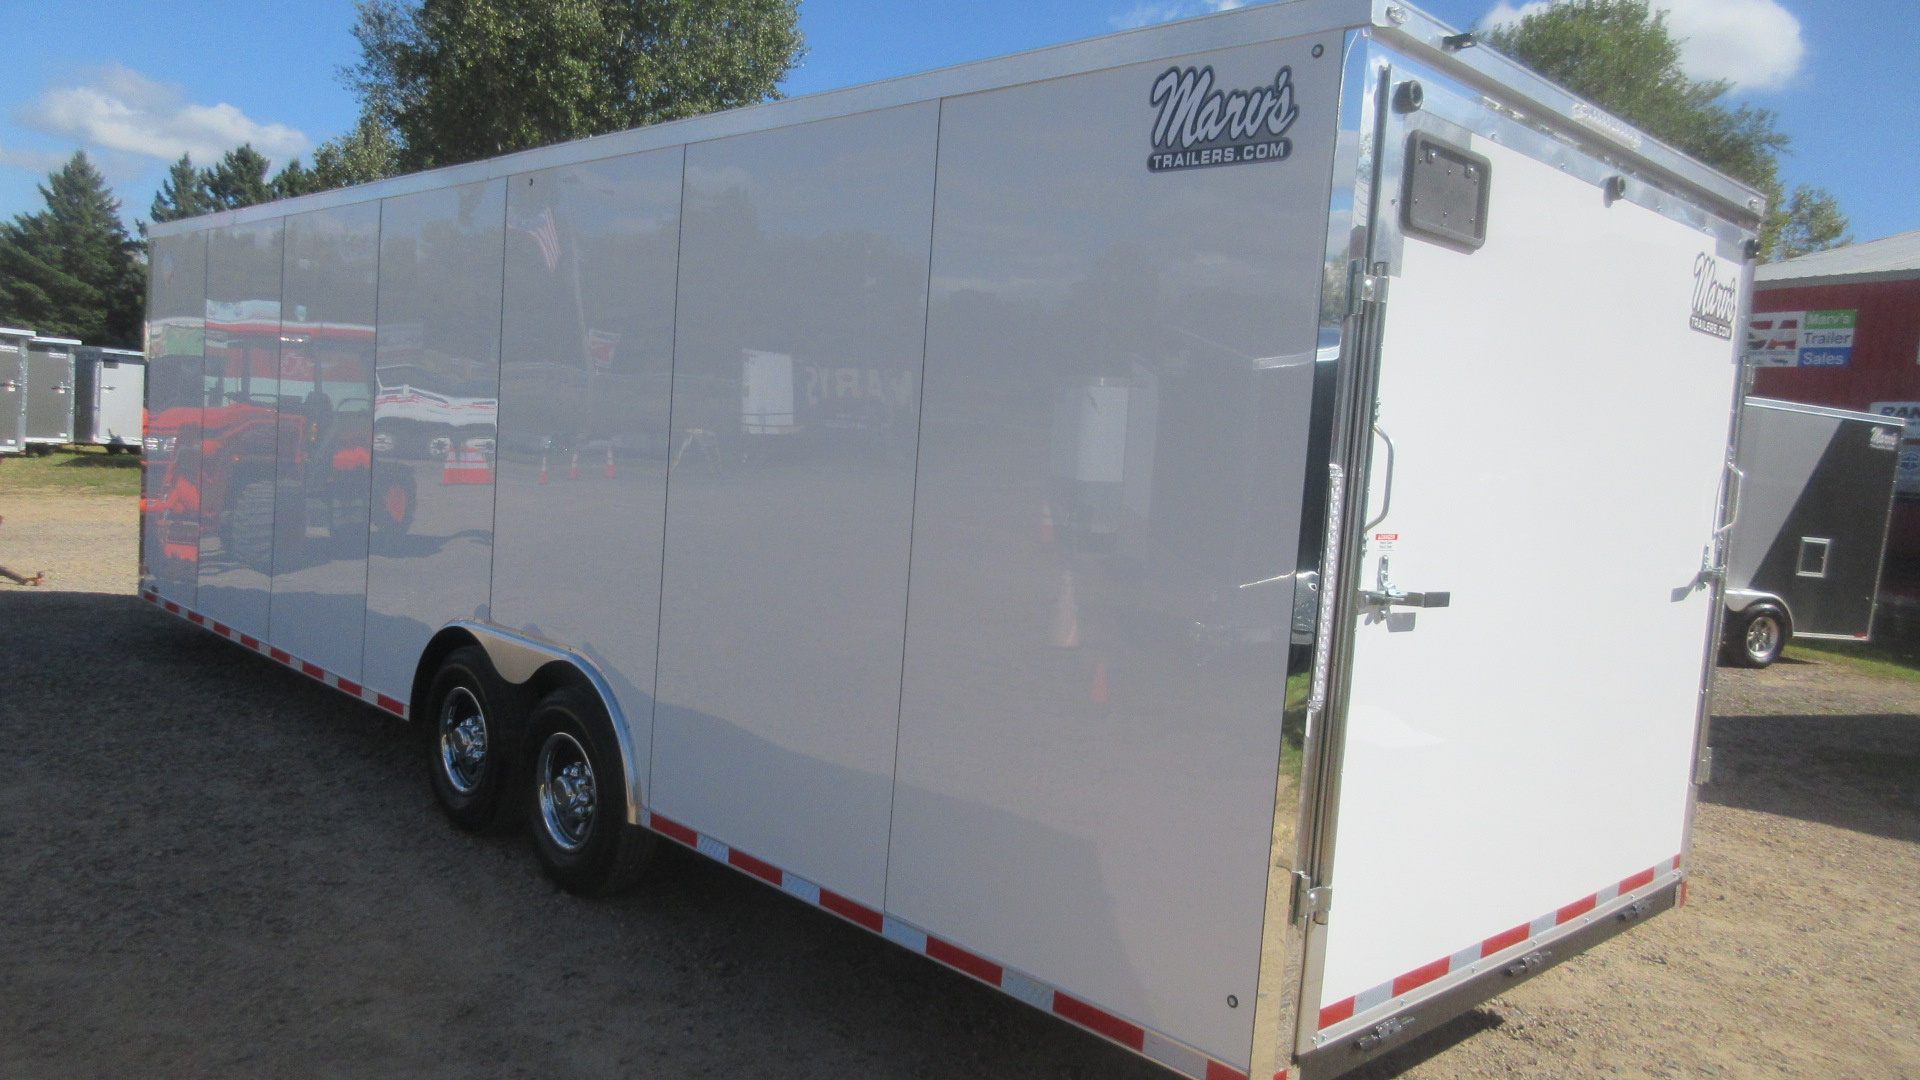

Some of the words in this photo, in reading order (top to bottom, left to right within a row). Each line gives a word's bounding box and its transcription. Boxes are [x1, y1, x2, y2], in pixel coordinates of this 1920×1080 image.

[1151, 65, 1299, 149] Marv's
[1152, 142, 1285, 169] TRAILERS.COM
[1690, 316, 1731, 338] TRAILERS.COM
[1807, 313, 1852, 325] Marv's
[1804, 332, 1851, 345] Trailer
[1803, 352, 1844, 365] Sales
